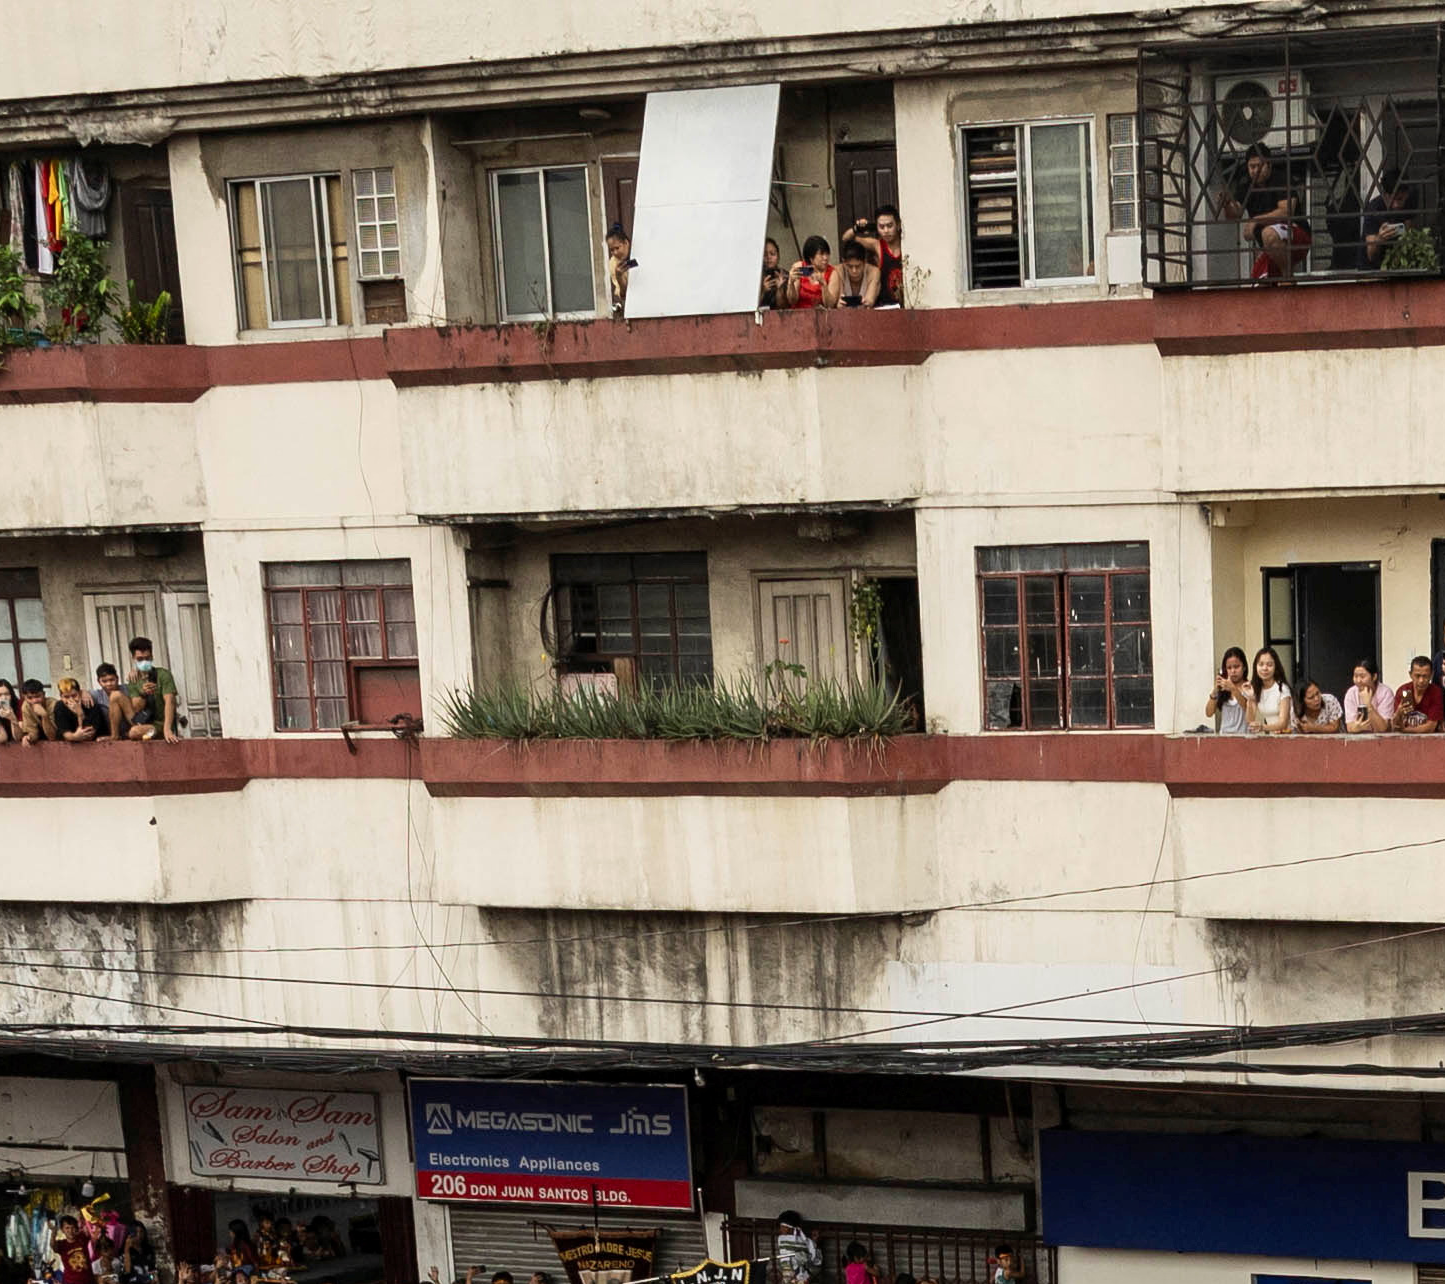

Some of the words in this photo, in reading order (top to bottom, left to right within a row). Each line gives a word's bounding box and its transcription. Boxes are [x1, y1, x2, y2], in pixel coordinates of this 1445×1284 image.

[189, 1091, 277, 1124] Sam
[288, 1094, 375, 1128] Sam
[456, 1110, 595, 1134] MEGASONIC
[232, 1125, 301, 1147] Salon
[306, 1129, 335, 1151] and
[210, 1148, 297, 1170] Barber
[303, 1155, 361, 1180] Shop
[429, 1153, 510, 1168] Electronics
[519, 1155, 601, 1173] Appliances
[431, 1174, 467, 1195] 206
[470, 1184, 497, 1198] DON
[501, 1185, 534, 1199] JUAN
[538, 1187, 589, 1201] SANTOS
[578, 1259, 635, 1269] NAZARENO
